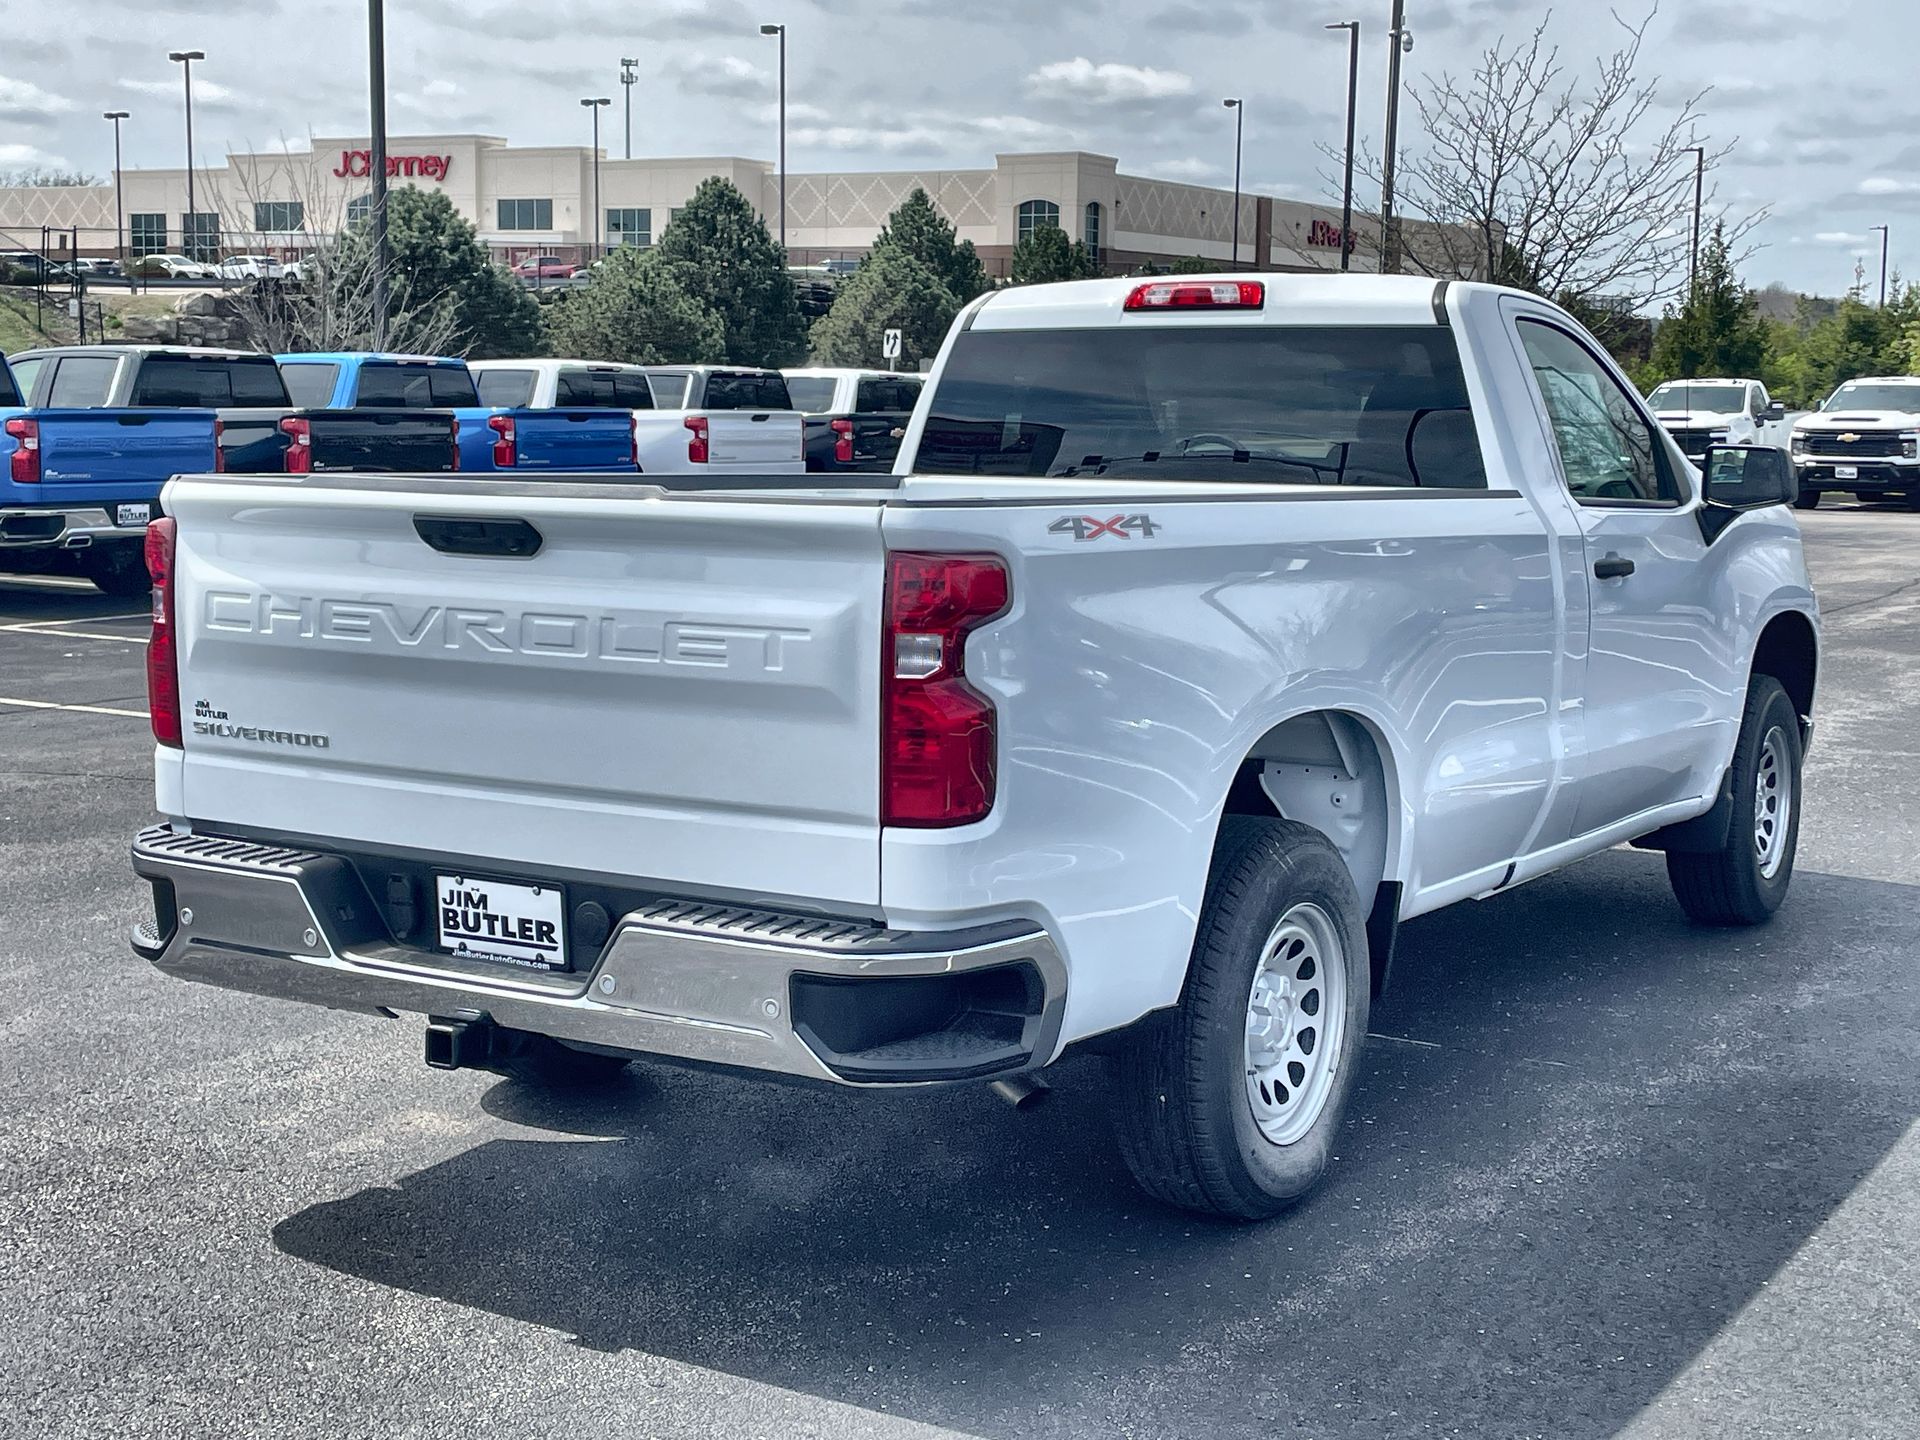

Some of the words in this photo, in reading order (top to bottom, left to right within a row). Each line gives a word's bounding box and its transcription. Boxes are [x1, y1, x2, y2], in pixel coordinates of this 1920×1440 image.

[205, 590, 812, 671] CHEVROLET
[195, 700, 210, 709] JIM
[195, 708, 229, 720] BUTLER
[193, 721, 330, 748] SILVERADO
[442, 889, 488, 912] JIM
[442, 906, 559, 944] BUTLER
[452, 948, 550, 970] JimButlerAutoGroup.com
